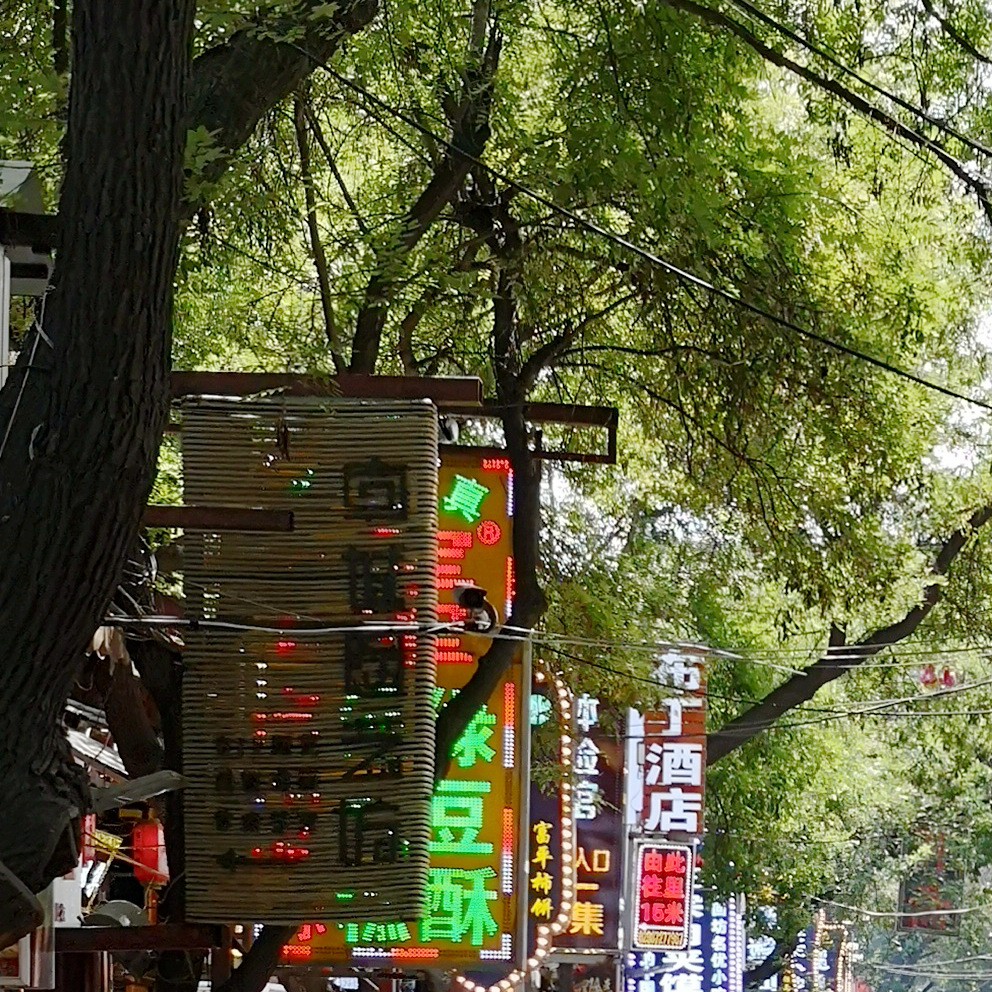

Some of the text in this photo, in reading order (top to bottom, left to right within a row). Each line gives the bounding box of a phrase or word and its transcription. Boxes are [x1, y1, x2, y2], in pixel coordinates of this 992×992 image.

[530, 820, 554, 920] 富平柿饼
[643, 848, 686, 874] 由此
[640, 901, 684, 925] 15米
